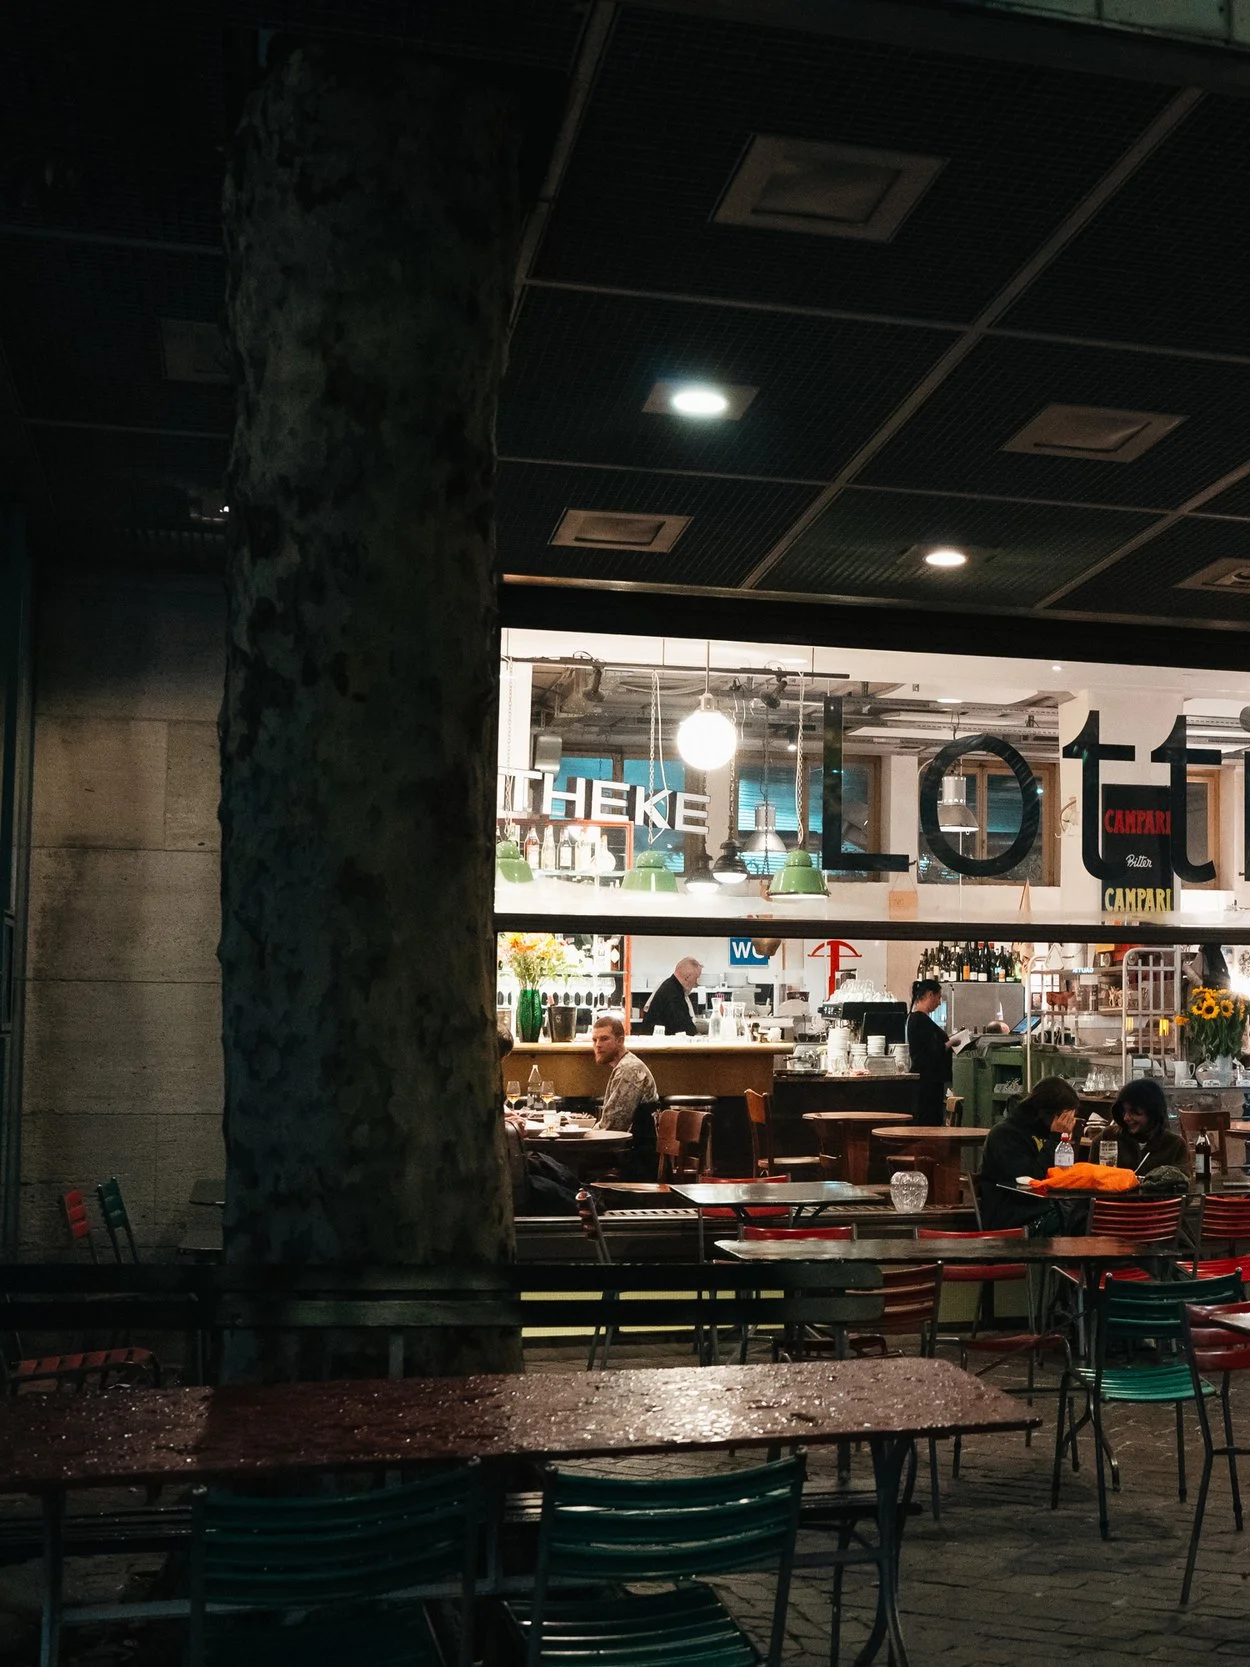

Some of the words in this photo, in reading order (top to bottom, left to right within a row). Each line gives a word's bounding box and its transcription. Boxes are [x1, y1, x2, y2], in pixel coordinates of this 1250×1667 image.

[497, 766, 711, 834] THEKE
[1104, 809, 1171, 835] CAMPARI
[1126, 854, 1152, 868] Bitter
[1104, 888, 1172, 912] CAMPARI
